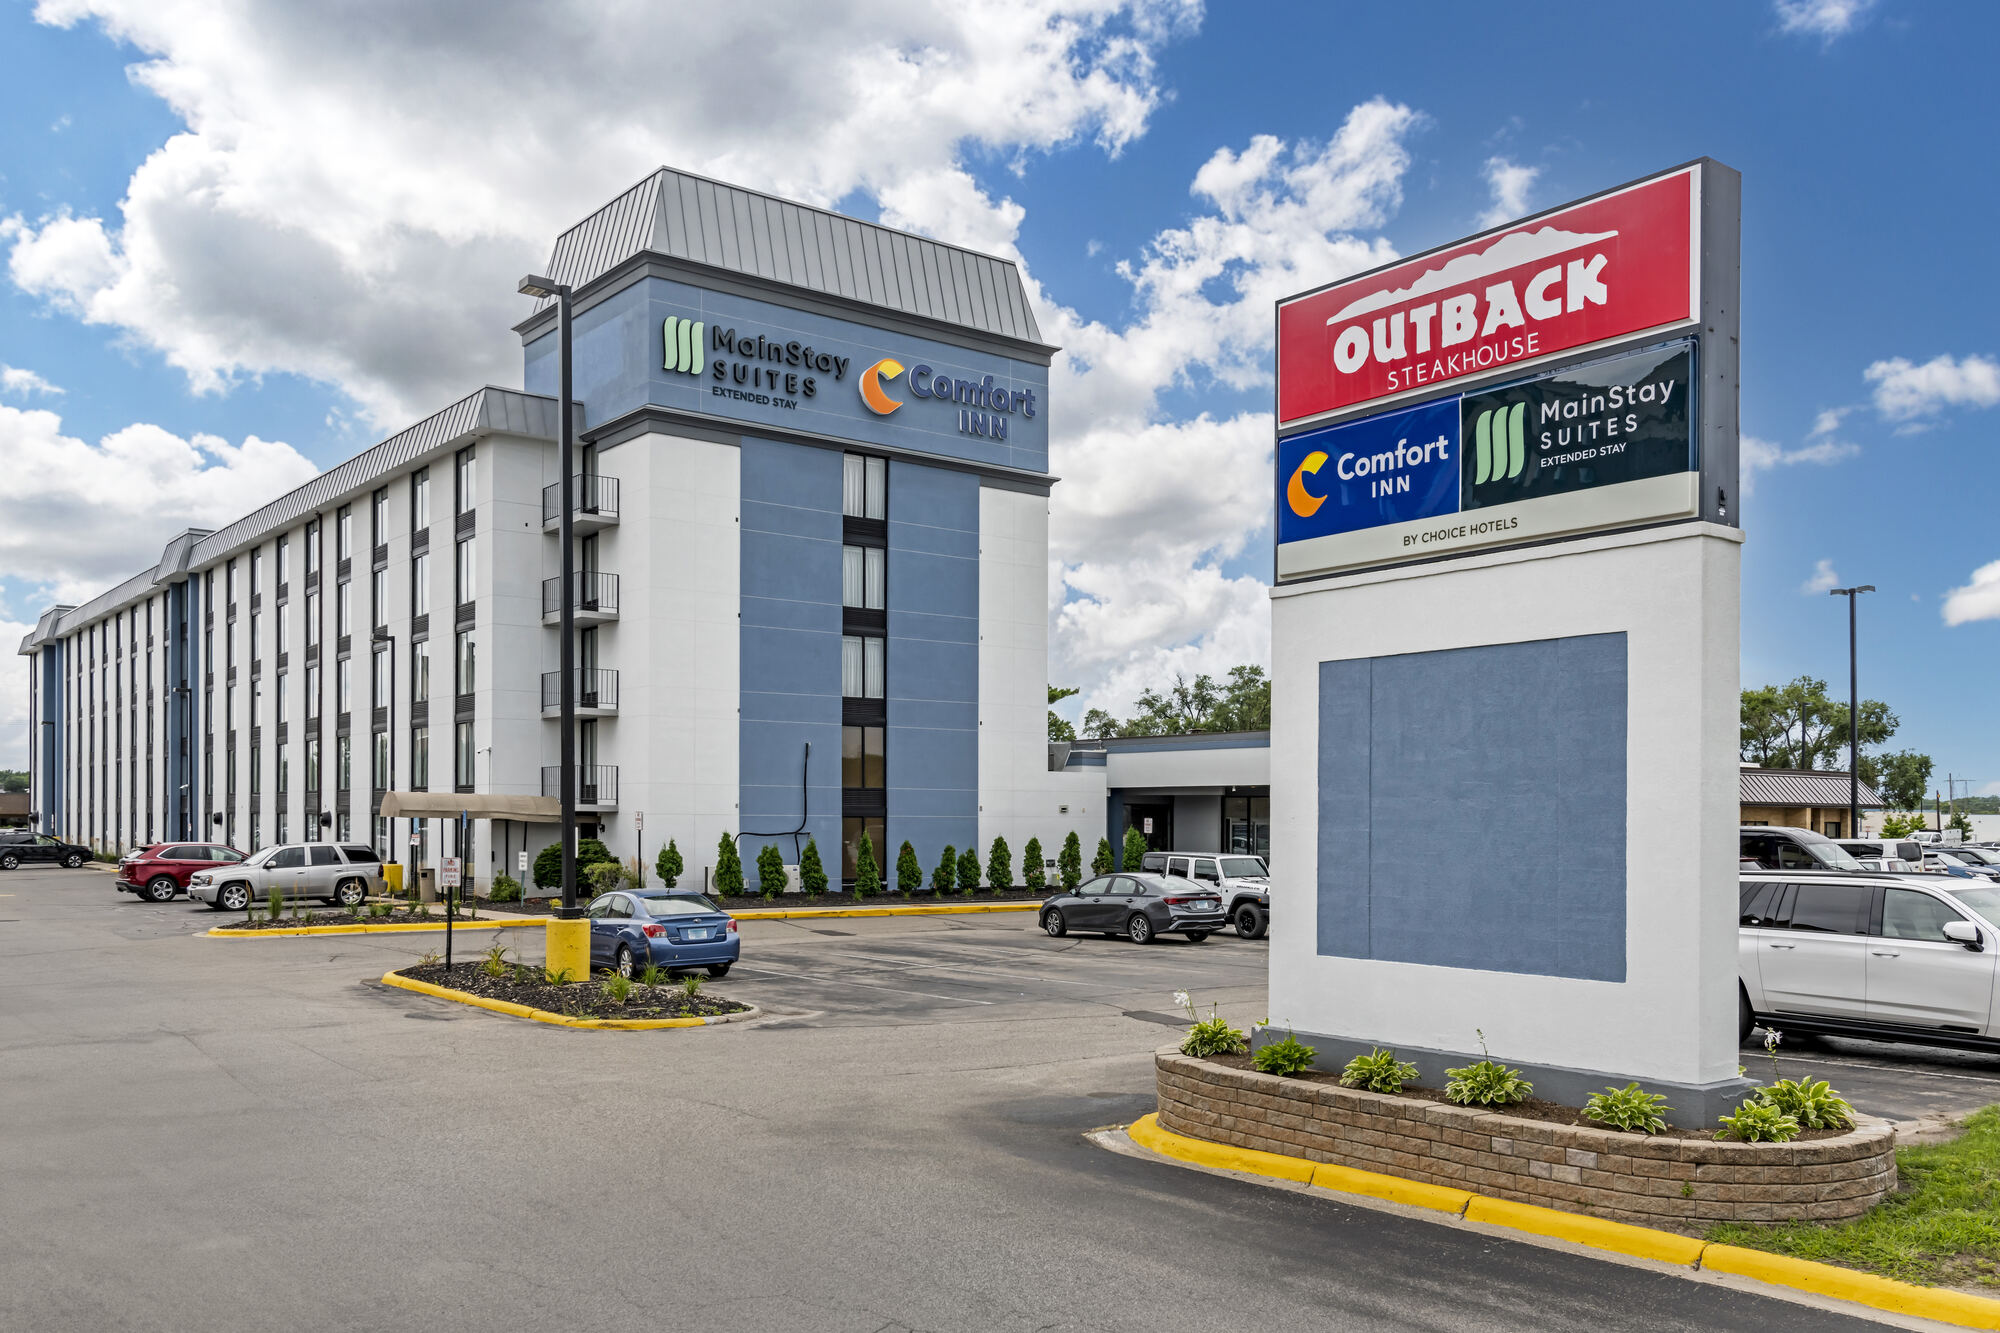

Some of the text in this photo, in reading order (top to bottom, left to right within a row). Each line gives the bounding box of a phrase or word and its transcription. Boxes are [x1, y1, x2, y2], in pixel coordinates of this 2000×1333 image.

[1333, 253, 1608, 375] OUTBACK
[712, 324, 850, 380] MainStay
[1388, 332, 1540, 391] STEAKHOUSE
[712, 359, 817, 397] SUITES
[908, 363, 1036, 418] Comfort
[712, 385, 798, 410] EXTENDED STAY
[1540, 379, 1676, 425] MainStay
[958, 409, 1008, 439] INN
[1540, 413, 1639, 450] SUITES
[1337, 434, 1449, 481] Comfort
[1540, 442, 1627, 468] EXTENDED STAY
[1371, 475, 1411, 499] INN
[1402, 517, 1518, 547] BY CHOICE HOTELS
